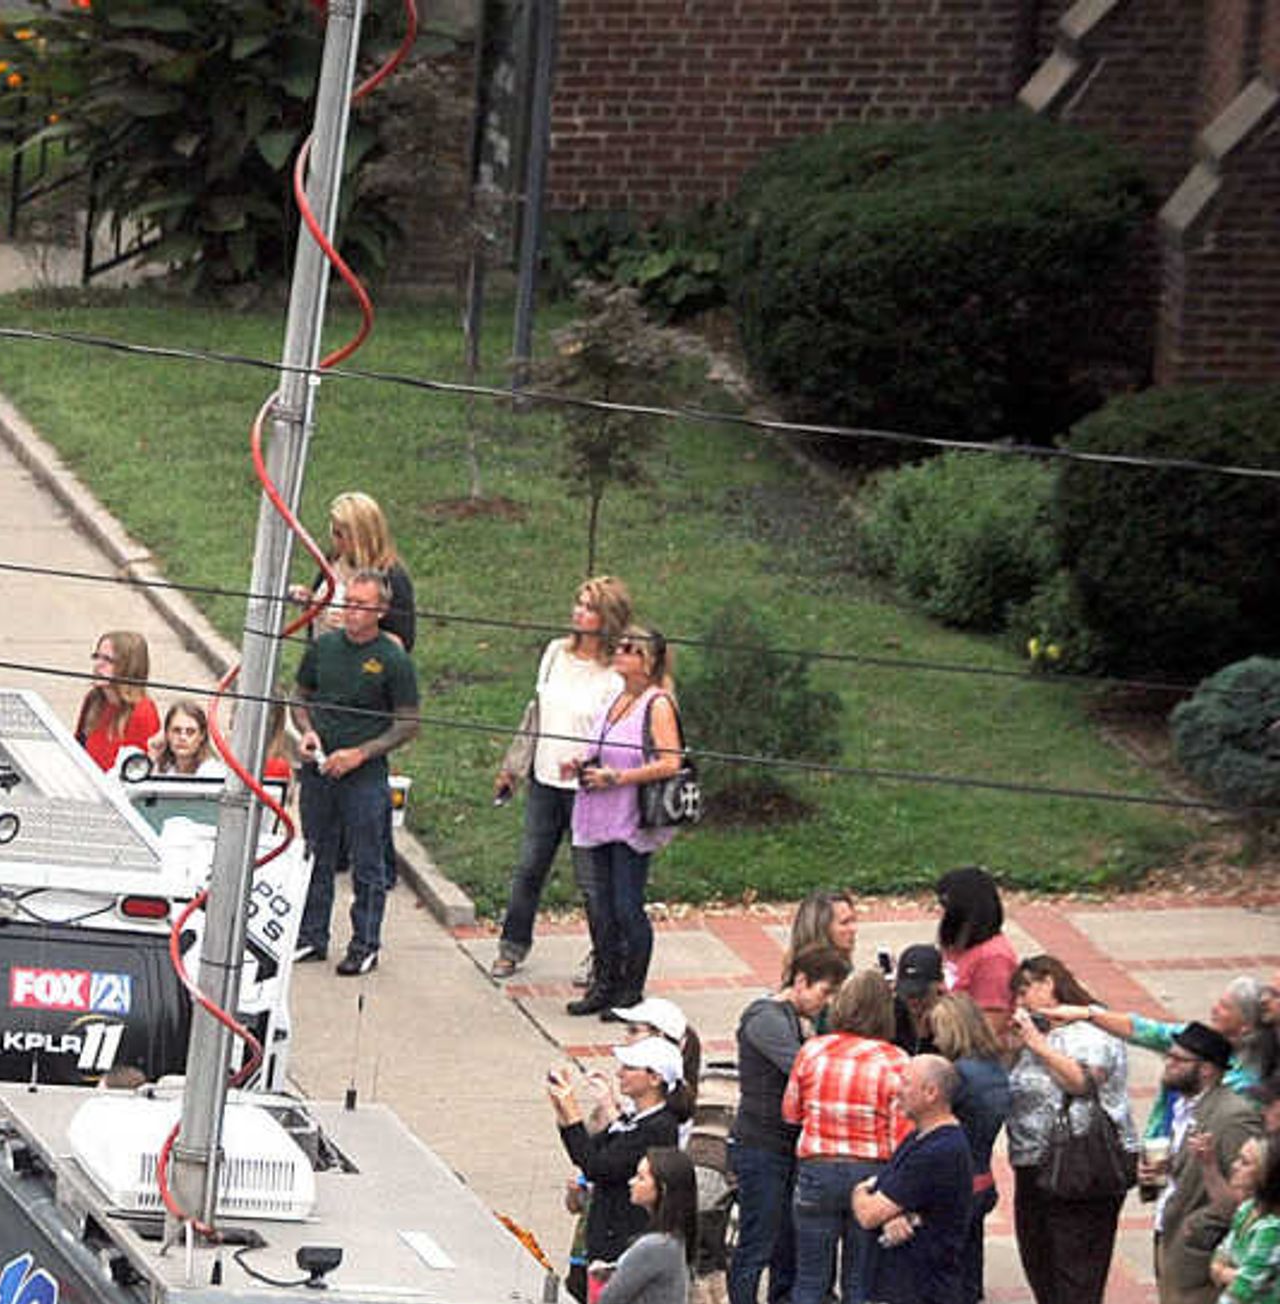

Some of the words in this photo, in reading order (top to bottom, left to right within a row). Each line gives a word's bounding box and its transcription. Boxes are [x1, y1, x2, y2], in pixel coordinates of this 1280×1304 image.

[12, 971, 87, 1007] FOX
[93, 973, 129, 1012] 2
[3, 1030, 82, 1054] KPLR
[77, 1022, 125, 1070] 11
